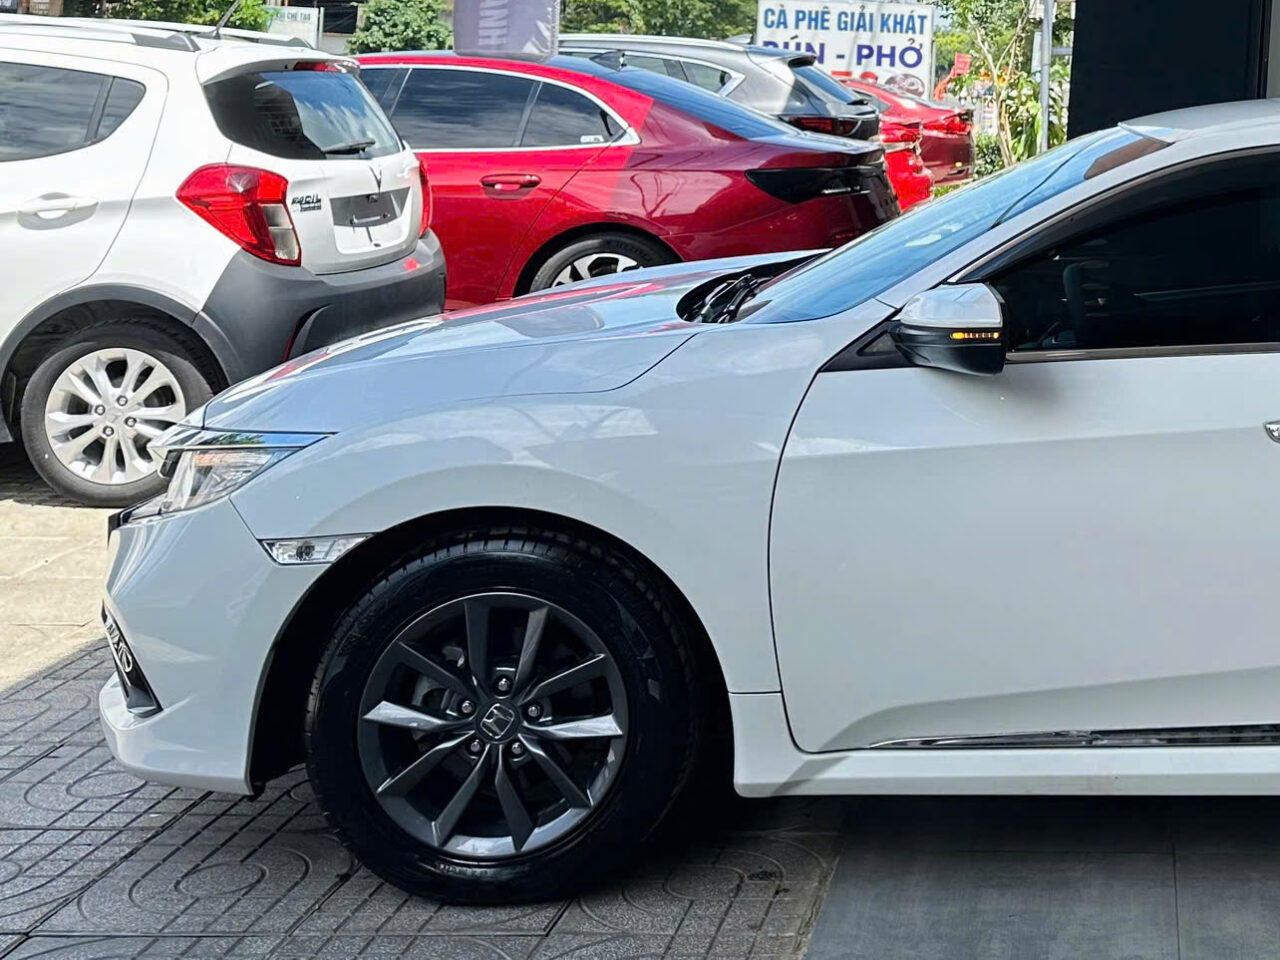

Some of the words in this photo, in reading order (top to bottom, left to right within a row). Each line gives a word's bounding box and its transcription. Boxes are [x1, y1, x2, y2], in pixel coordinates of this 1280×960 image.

[763, 4, 788, 29] CÀ
[795, 6, 831, 31] PHÊ
[837, 5, 874, 32] GIẢI
[880, 9, 928, 35] KHÁT
[856, 38, 923, 69] PHỞ
